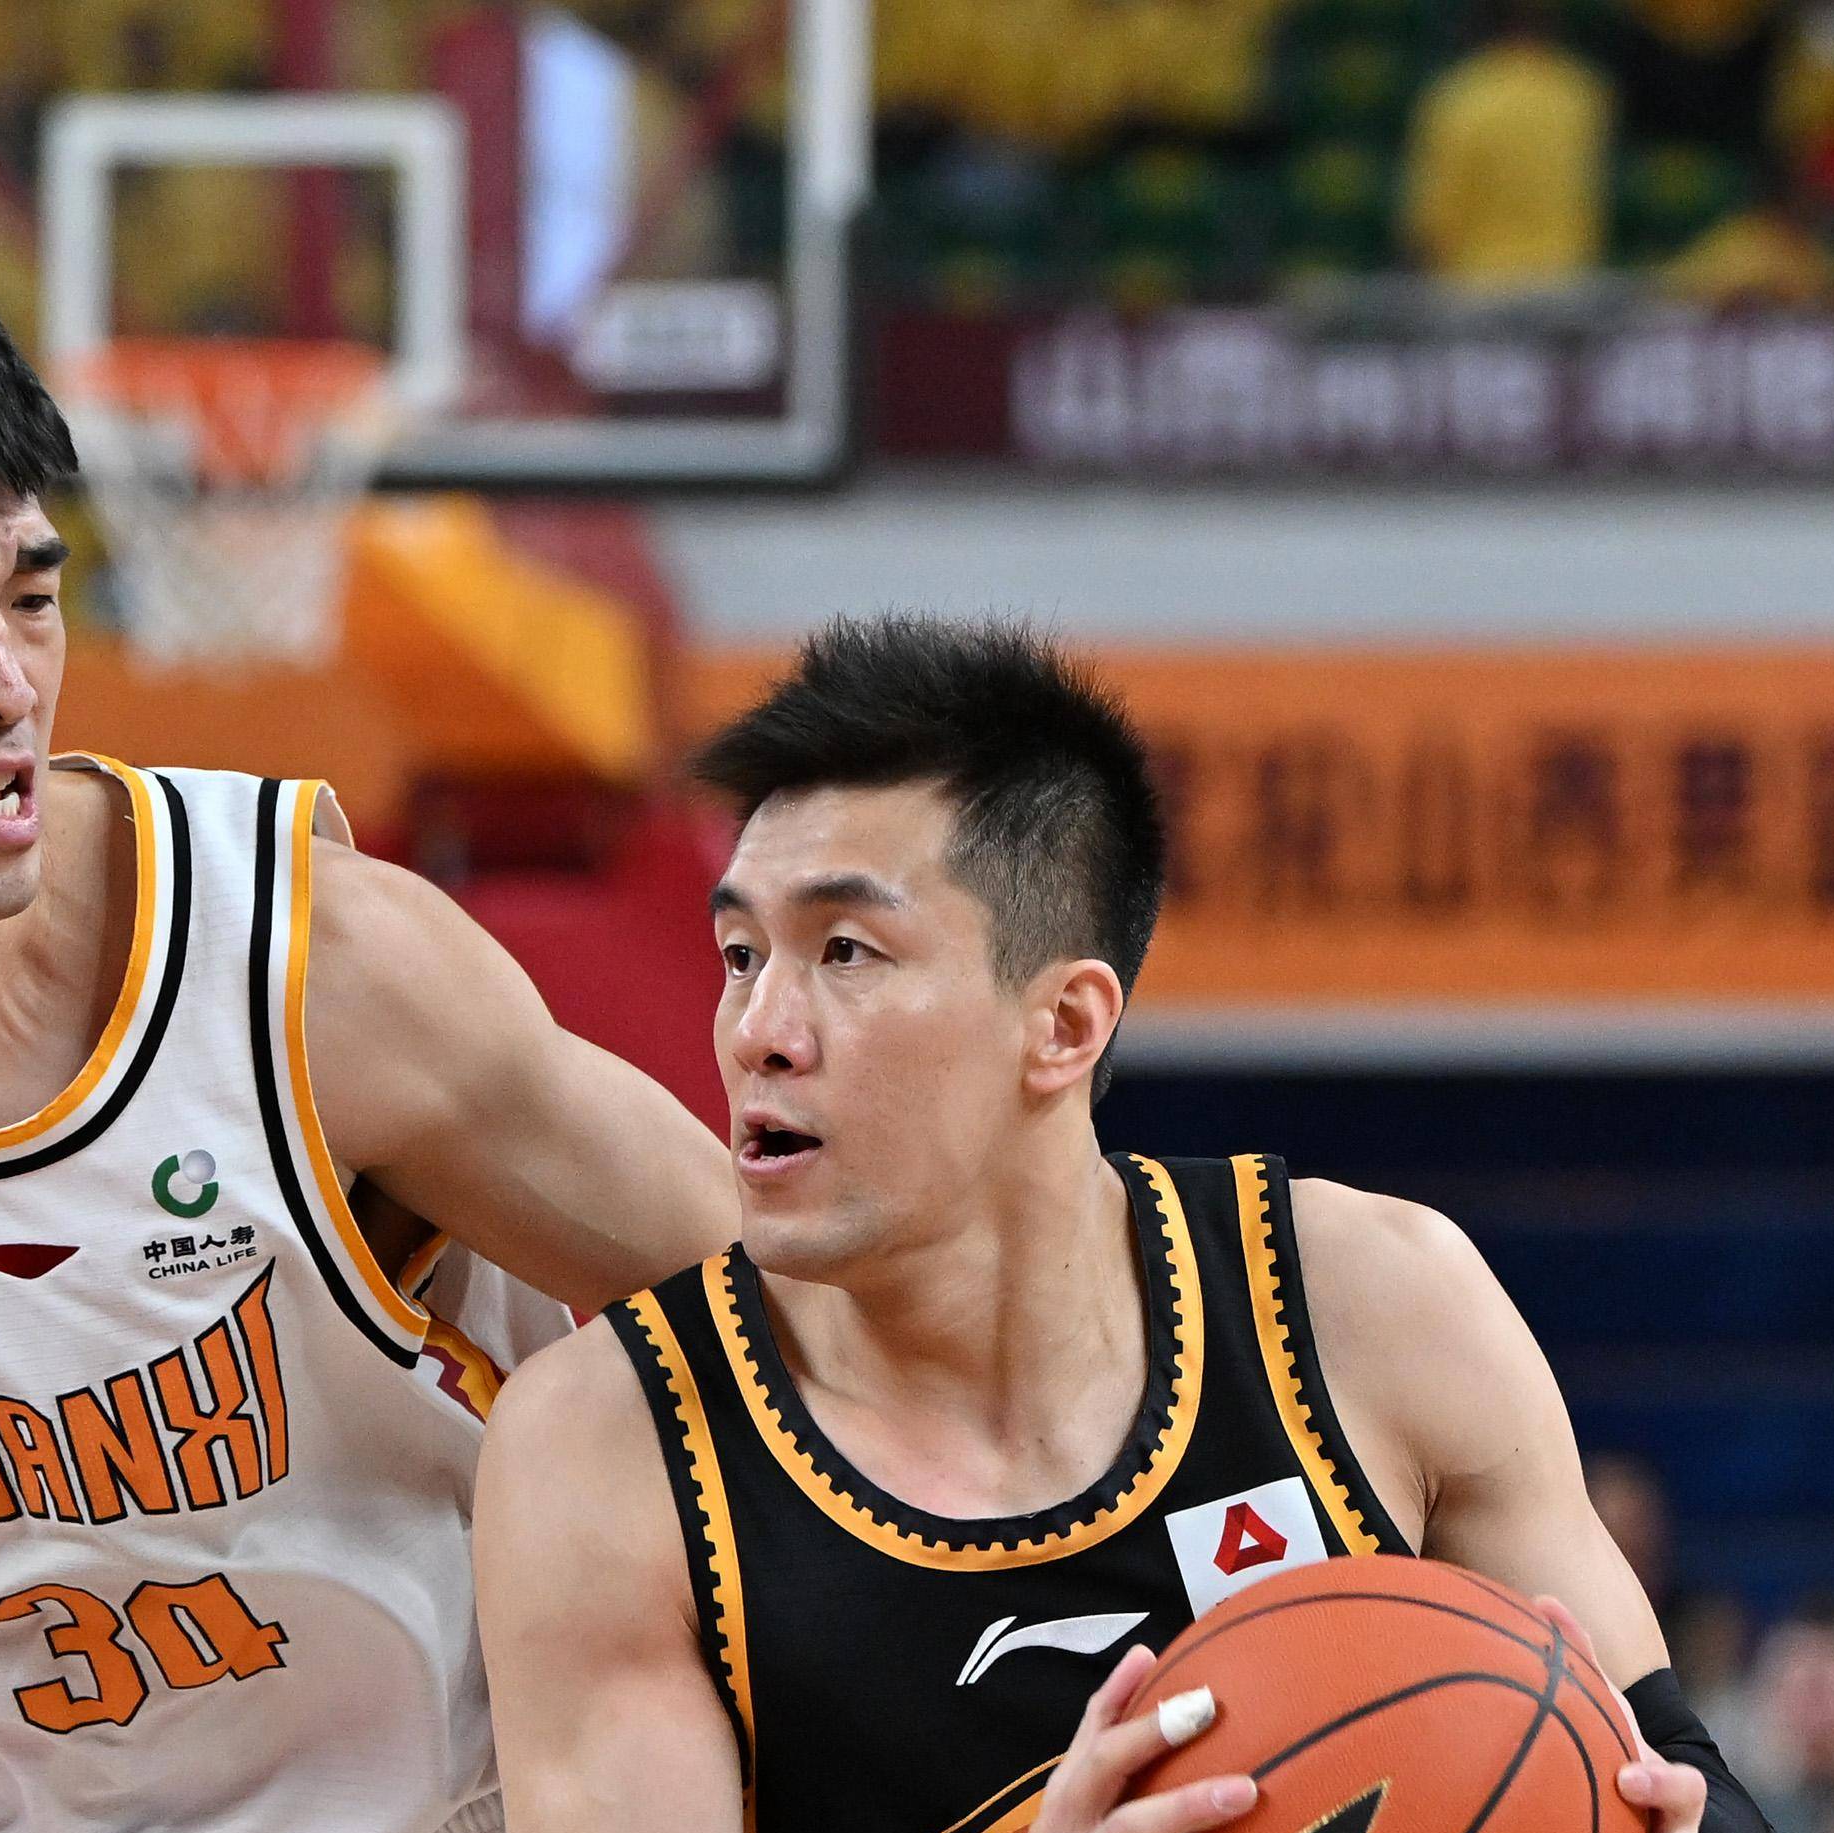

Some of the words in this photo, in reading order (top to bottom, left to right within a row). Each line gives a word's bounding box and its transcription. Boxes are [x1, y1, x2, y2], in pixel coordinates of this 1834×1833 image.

[143, 1225, 255, 1262] 中国人寿
[148, 1259, 210, 1279] CHINA
[216, 1246, 258, 1267] LIFE
